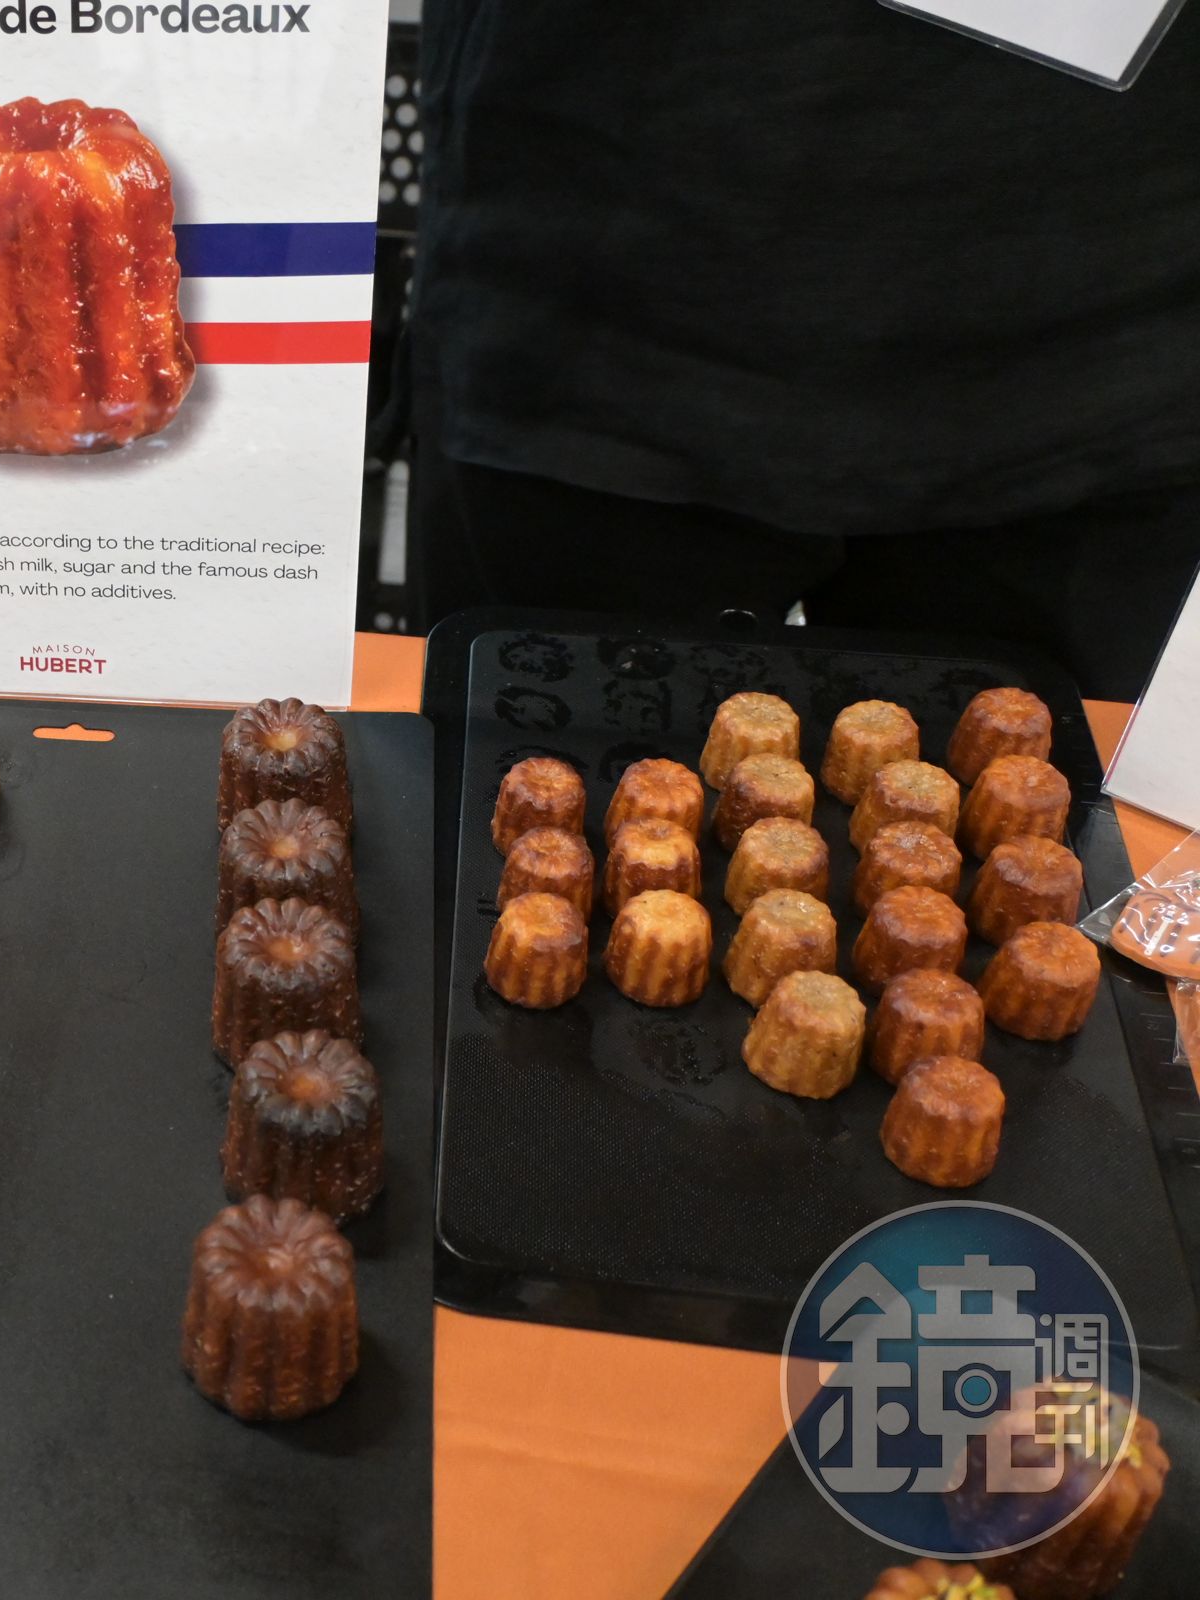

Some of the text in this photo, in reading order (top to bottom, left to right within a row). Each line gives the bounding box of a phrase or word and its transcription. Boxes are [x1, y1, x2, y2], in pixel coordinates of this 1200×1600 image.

[0, 0, 57, 35] de
[71, 0, 310, 34] Bordeaux
[0, 533, 92, 551] according
[97, 535, 118, 550] to
[123, 535, 155, 550] the
[160, 537, 257, 553] traditional
[262, 539, 326, 558] recipe:
[21, 557, 58, 573] milk,
[63, 561, 115, 577] sugar
[121, 561, 155, 575] and
[160, 561, 192, 576] the
[198, 561, 268, 578] famous
[273, 564, 319, 580] dash
[19, 581, 58, 596] with
[64, 585, 86, 597] no
[91, 584, 177, 600] additives.
[32, 644, 96, 657] MAISON
[19, 656, 107, 674] HUBERT
